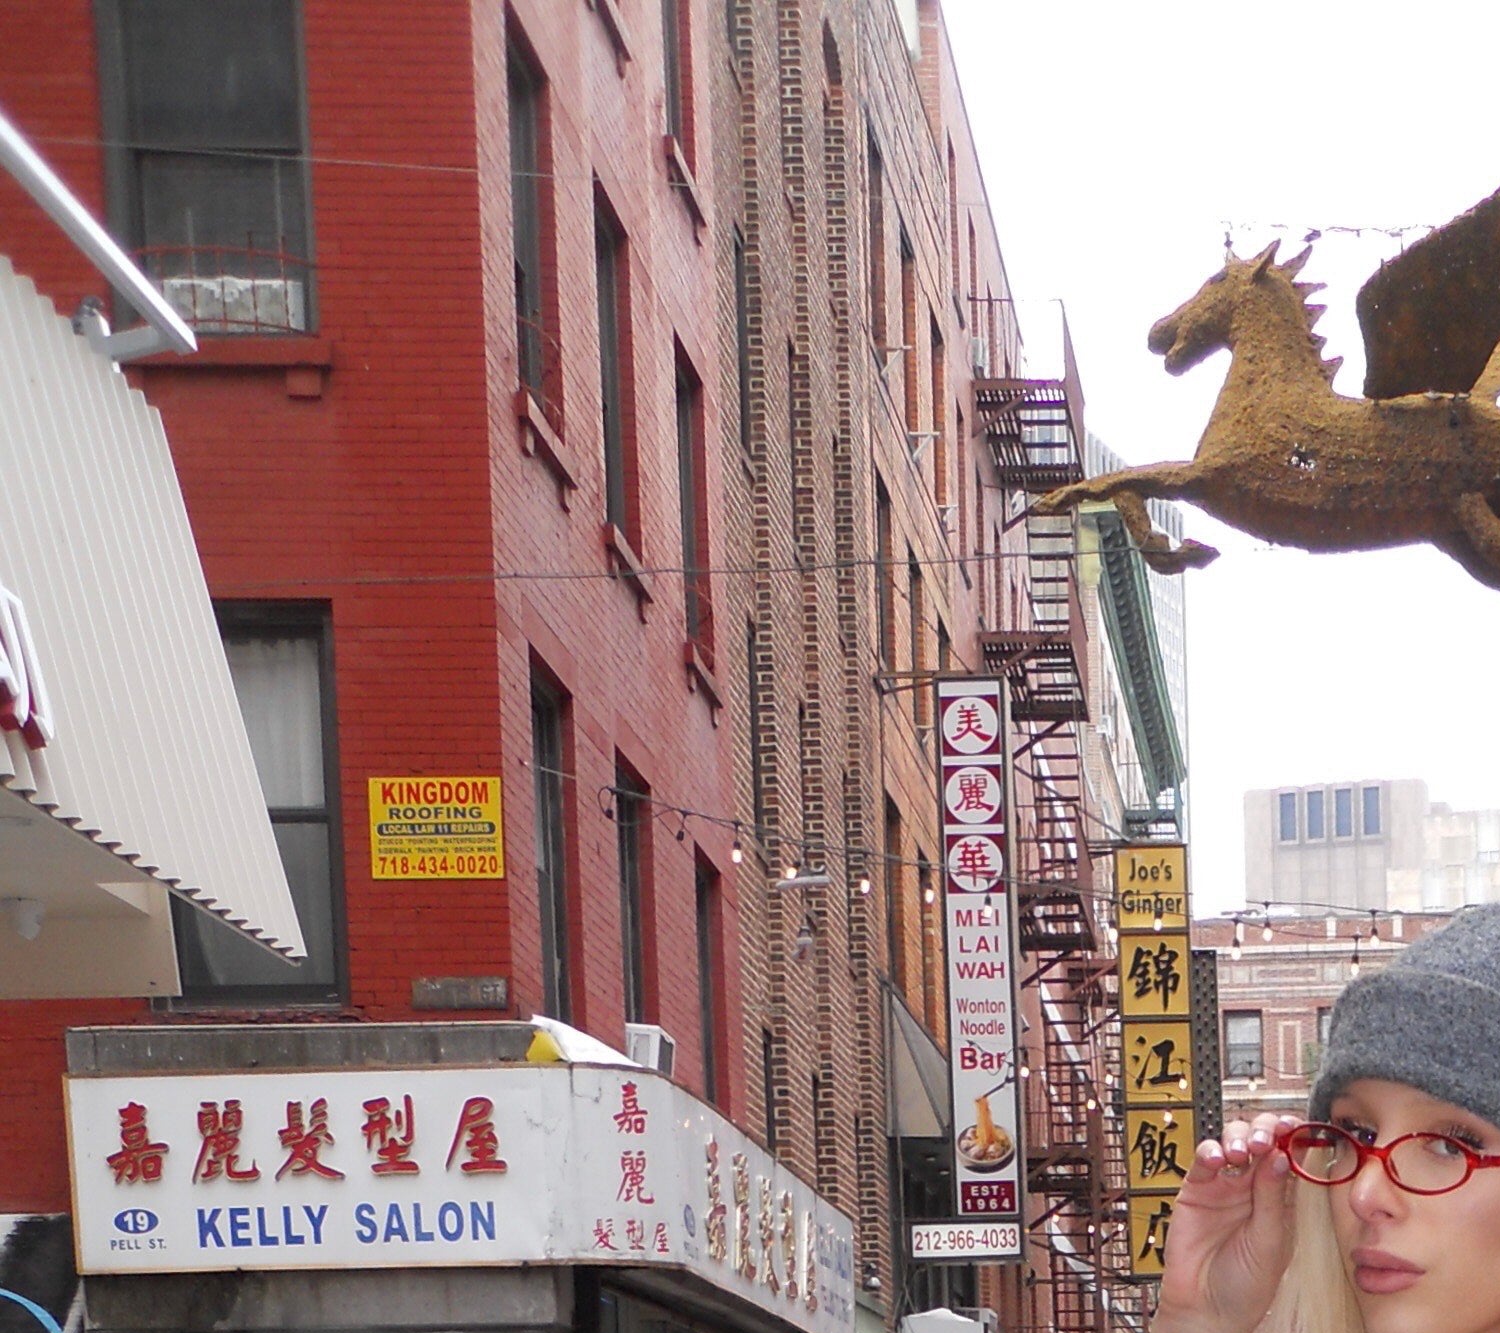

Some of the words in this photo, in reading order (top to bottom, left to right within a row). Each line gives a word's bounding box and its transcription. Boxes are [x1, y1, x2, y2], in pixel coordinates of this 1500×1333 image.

[381, 781, 489, 805] KINGDOM
[951, 703, 997, 887] 美麗華
[388, 806, 482, 820] ROOFING
[382, 824, 413, 834] LOCAL
[414, 824, 436, 834] LAW
[450, 823, 490, 834] REPAIRS
[378, 855, 498, 875] 718-434-0020
[1129, 858, 1173, 881] Joe's
[1121, 890, 1183, 917] Ginger
[955, 908, 1000, 927] MEI
[959, 935, 999, 953] LAI
[956, 961, 1005, 979] WAH
[956, 998, 1006, 1014] Wonton
[960, 1019, 1005, 1035] Noodle
[960, 1047, 1007, 1070] Bar
[106, 1094, 508, 1184] 嘉麗髮型屋
[613, 1080, 655, 1205] 嘉麗
[970, 1185, 1006, 1197] EST:
[965, 1198, 1010, 1210] 1964
[122, 1211, 149, 1233] 19
[196, 1204, 329, 1249] KELLY
[355, 1201, 496, 1244] SALON
[110, 1239, 142, 1250] PELL
[149, 1238, 167, 1250] ST.
[592, 1217, 670, 1253] 髮型屋
[914, 1228, 1018, 1251] 212-966-4033
